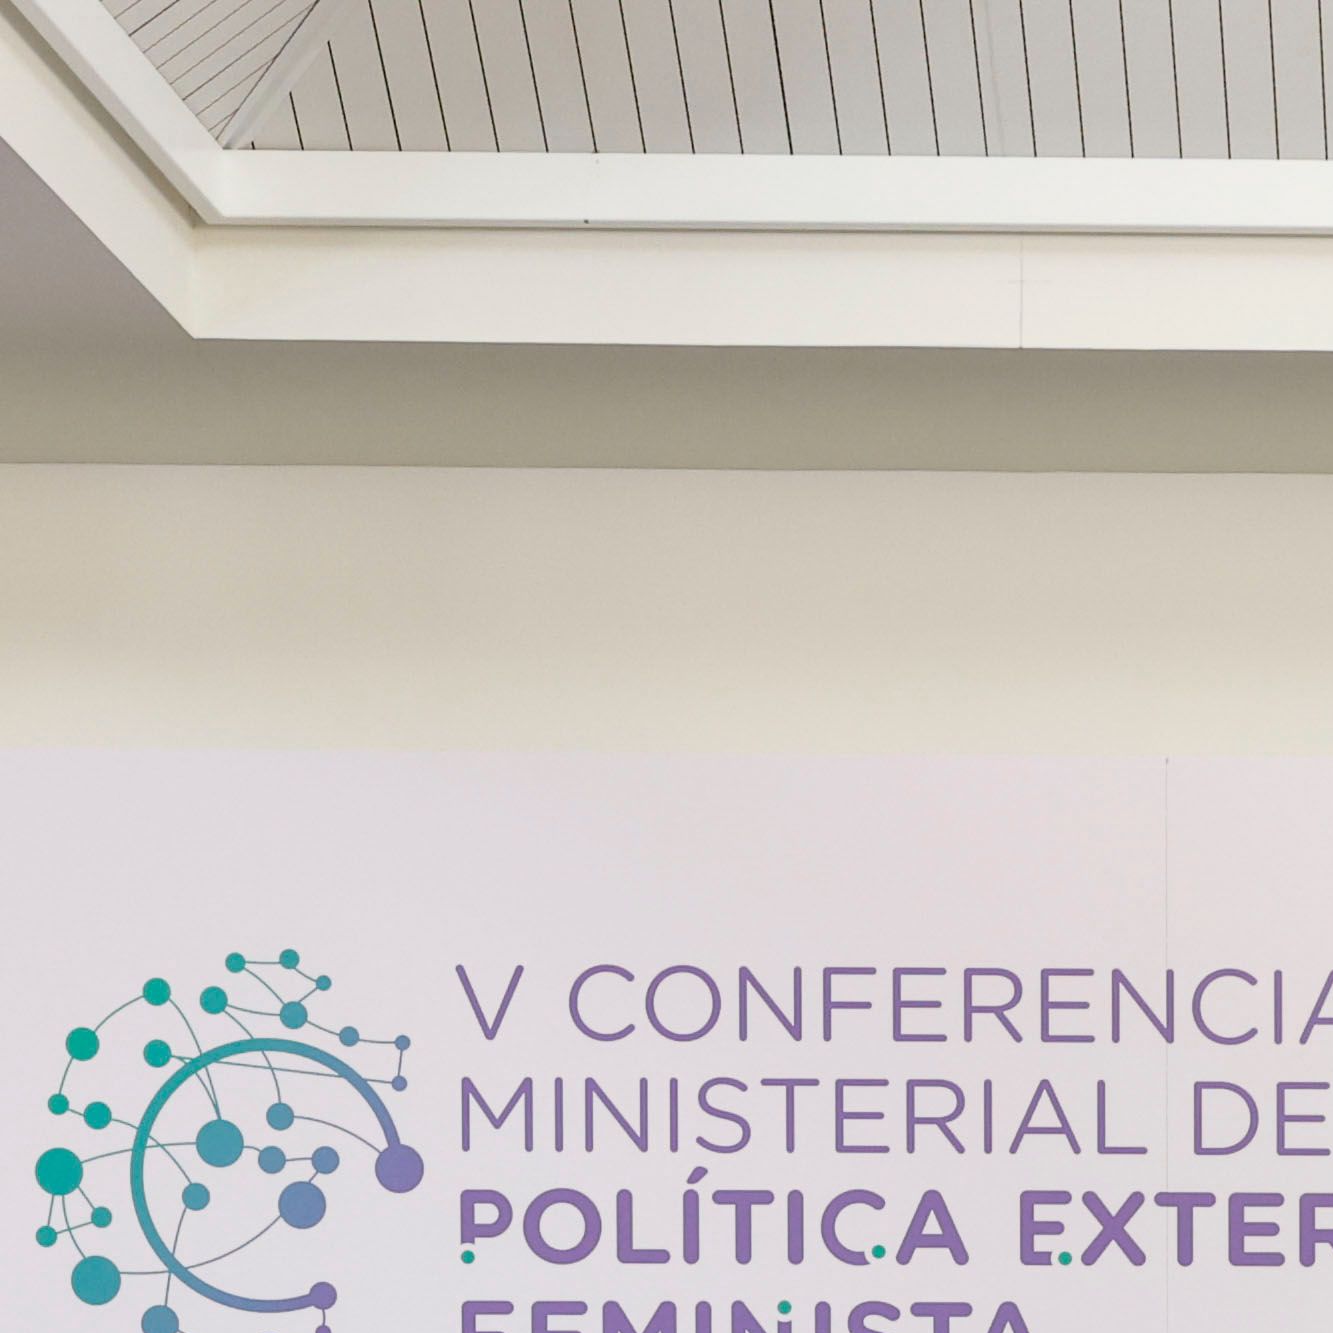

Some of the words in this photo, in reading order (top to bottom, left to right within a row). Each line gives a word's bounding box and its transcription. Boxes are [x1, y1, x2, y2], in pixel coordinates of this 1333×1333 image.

[456, 965, 524, 1041] V
[461, 1076, 1148, 1156] MINISTERIAL
[1194, 1081, 1331, 1157] DE
[460, 1166, 969, 1267] POLÍTICA
